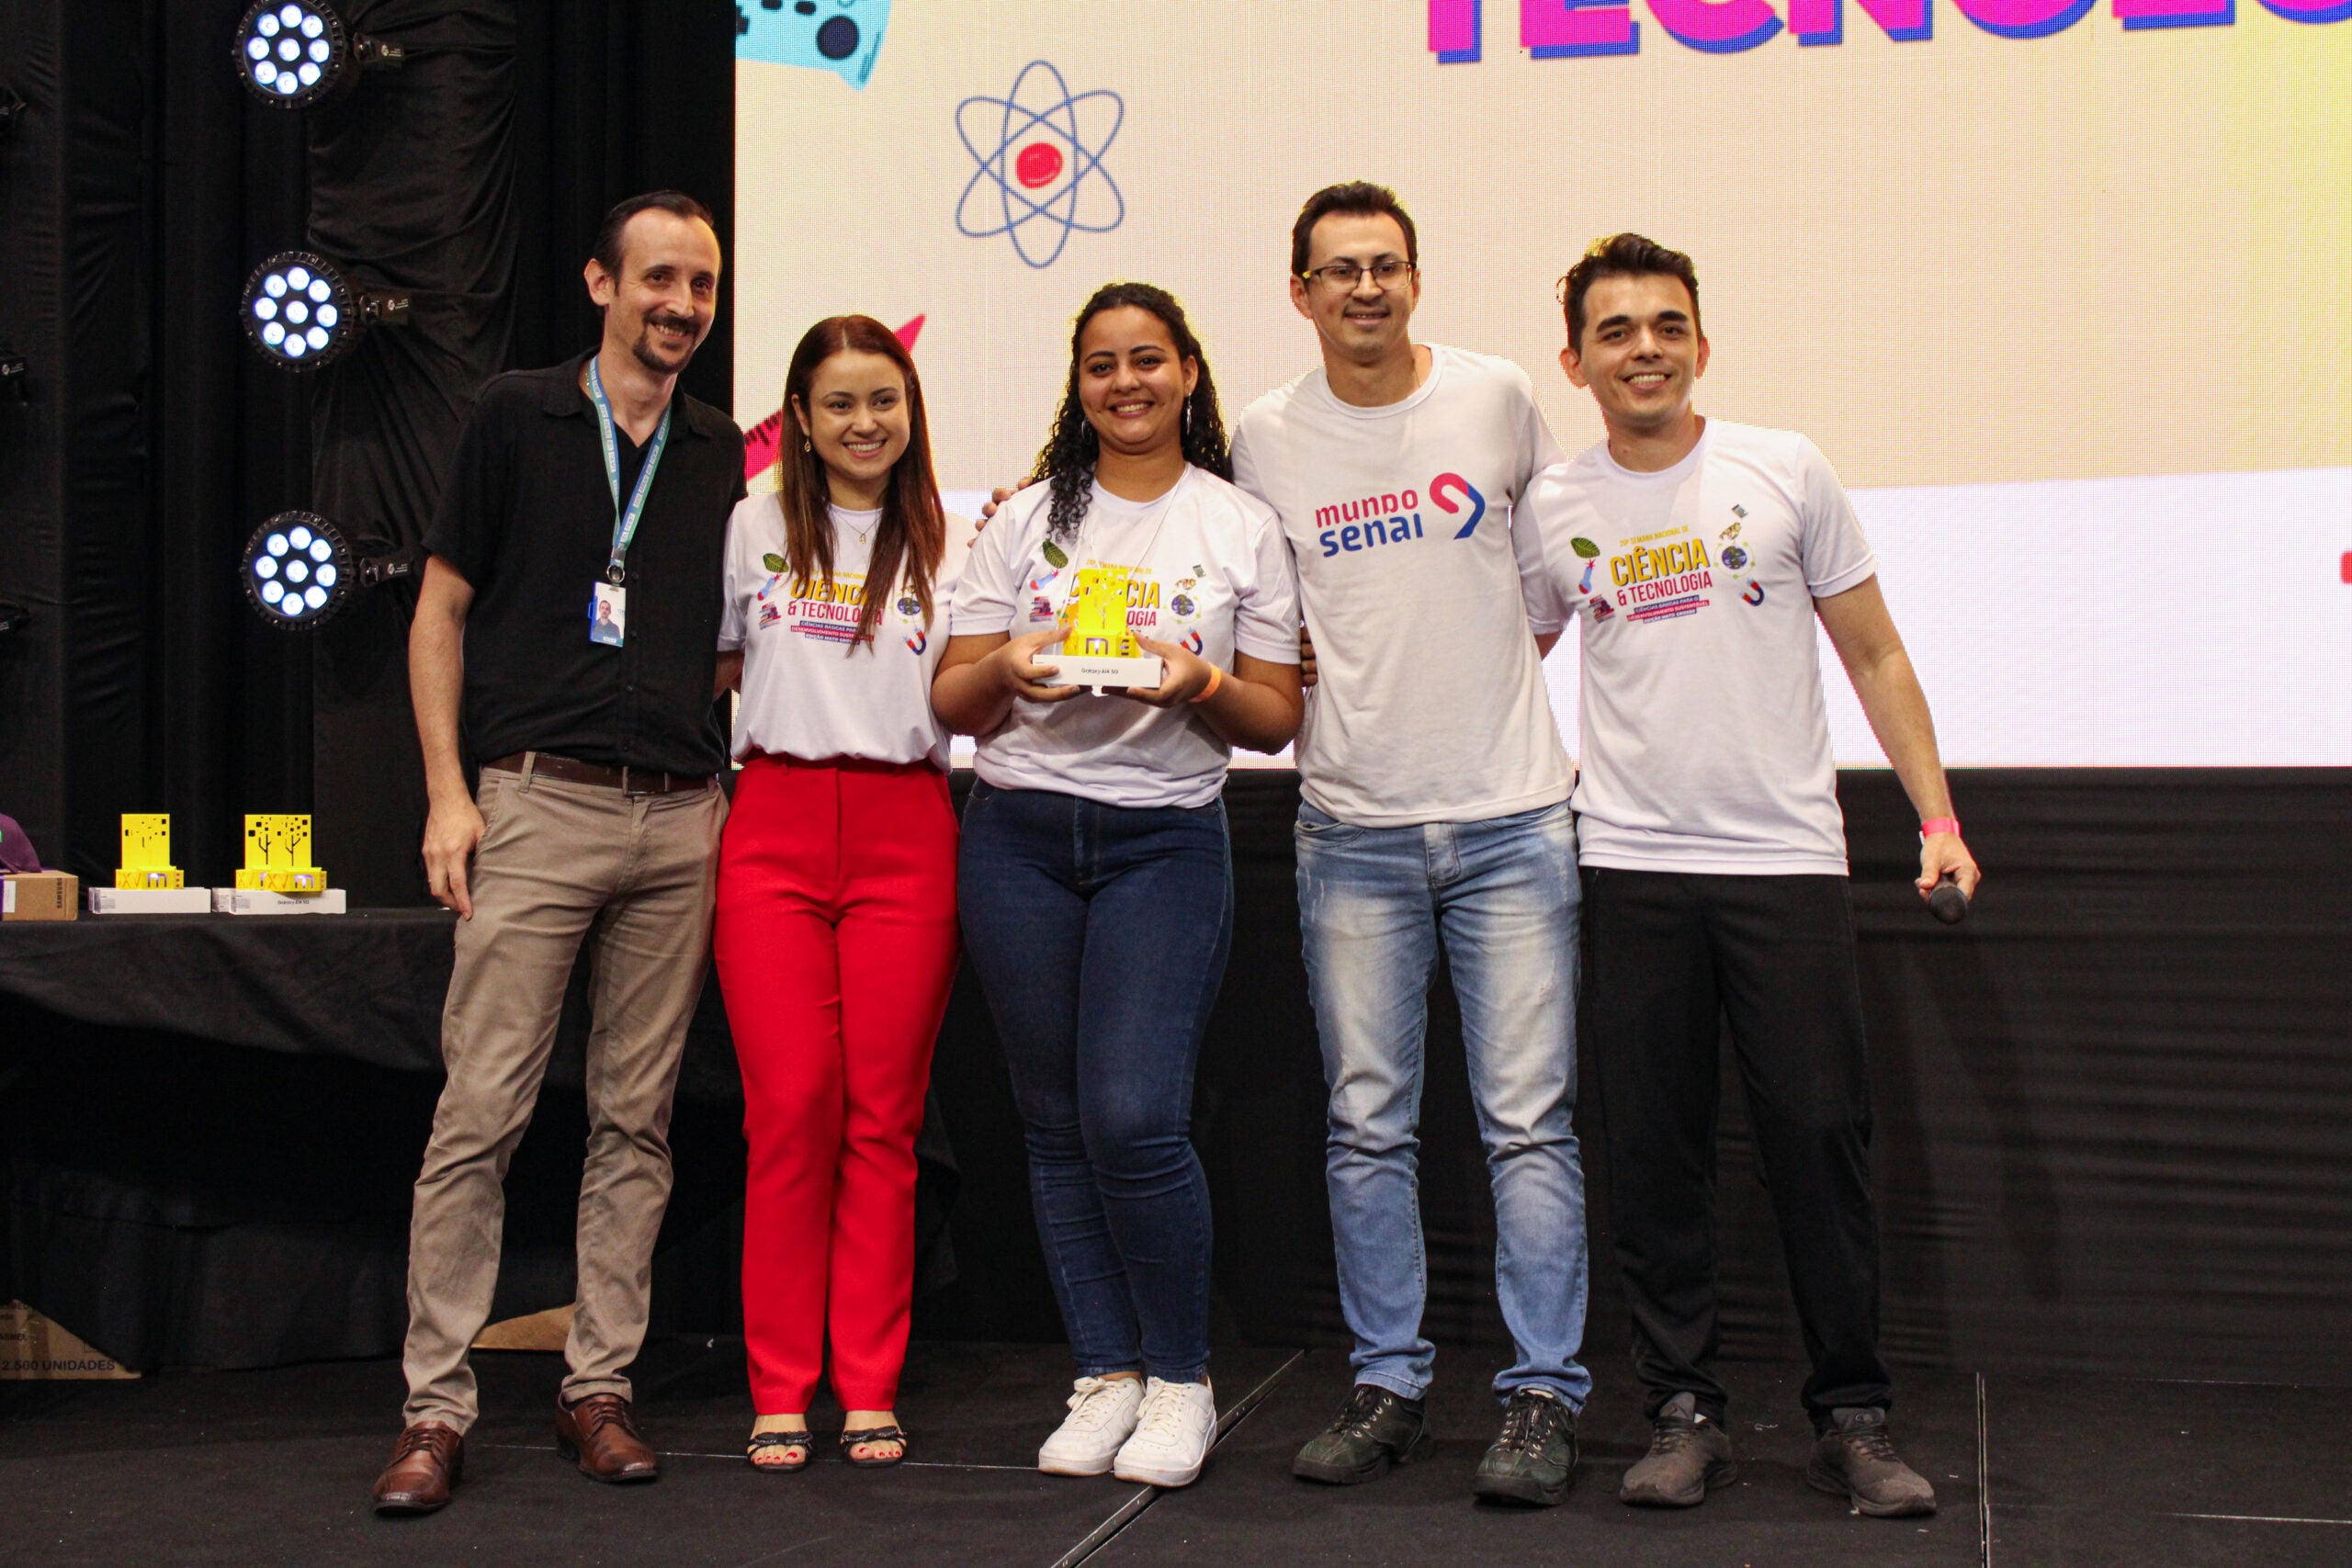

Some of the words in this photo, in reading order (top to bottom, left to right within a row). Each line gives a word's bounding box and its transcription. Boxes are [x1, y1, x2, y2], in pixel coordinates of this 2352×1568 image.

[1610, 538, 1711, 586] CIÊNCIA
[1617, 590, 1627, 606] &
[1628, 570, 1713, 603] TECNOLOGIA
[787, 601, 797, 615] &
[2, 1360, 39, 1371] 2.500
[42, 1359, 116, 1371] UNIDADES
